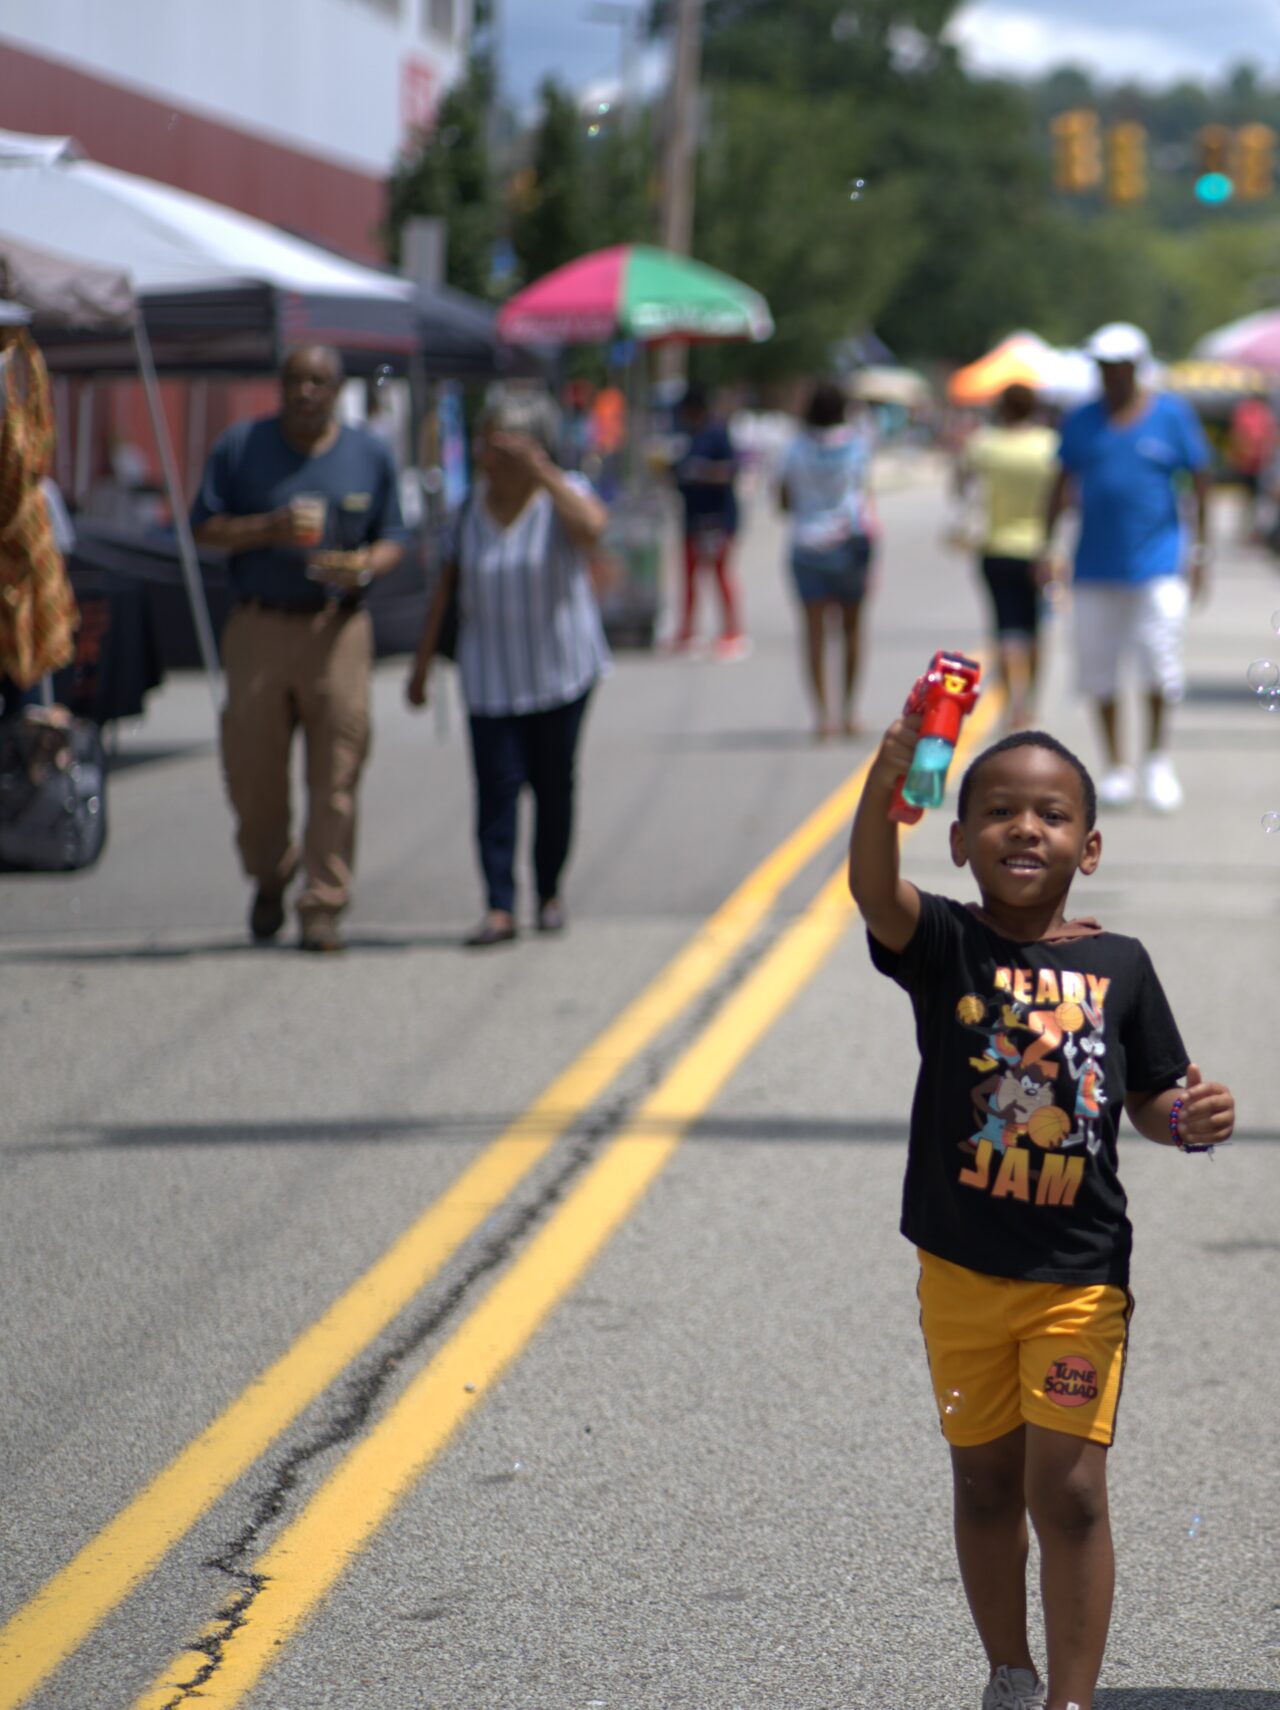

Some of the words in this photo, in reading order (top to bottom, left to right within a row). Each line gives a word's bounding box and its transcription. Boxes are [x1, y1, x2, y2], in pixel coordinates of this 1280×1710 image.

[959, 1138, 1086, 1207] JAM
[1053, 1361, 1096, 1383] TUNE
[1044, 1376, 1098, 1400] SQUAD
